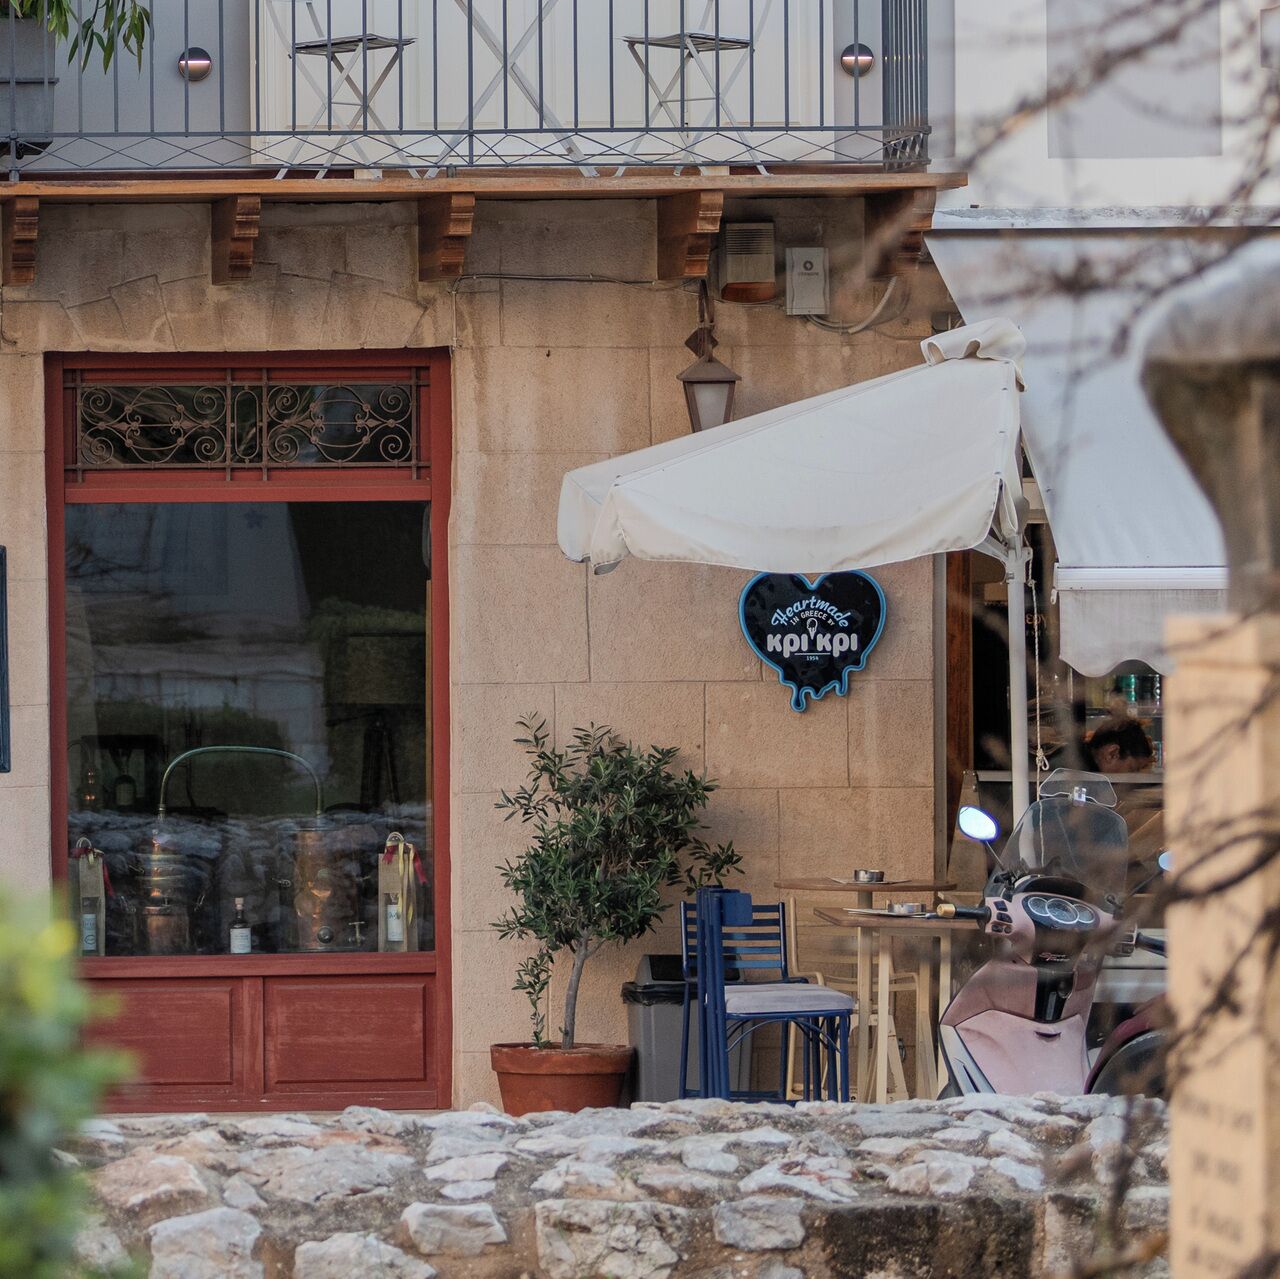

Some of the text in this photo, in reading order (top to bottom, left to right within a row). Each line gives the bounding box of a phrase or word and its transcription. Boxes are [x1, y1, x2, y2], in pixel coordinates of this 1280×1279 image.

[771, 595, 851, 627] Heartmade
[790, 616, 800, 626] IN
[800, 610, 828, 621] GREECE
